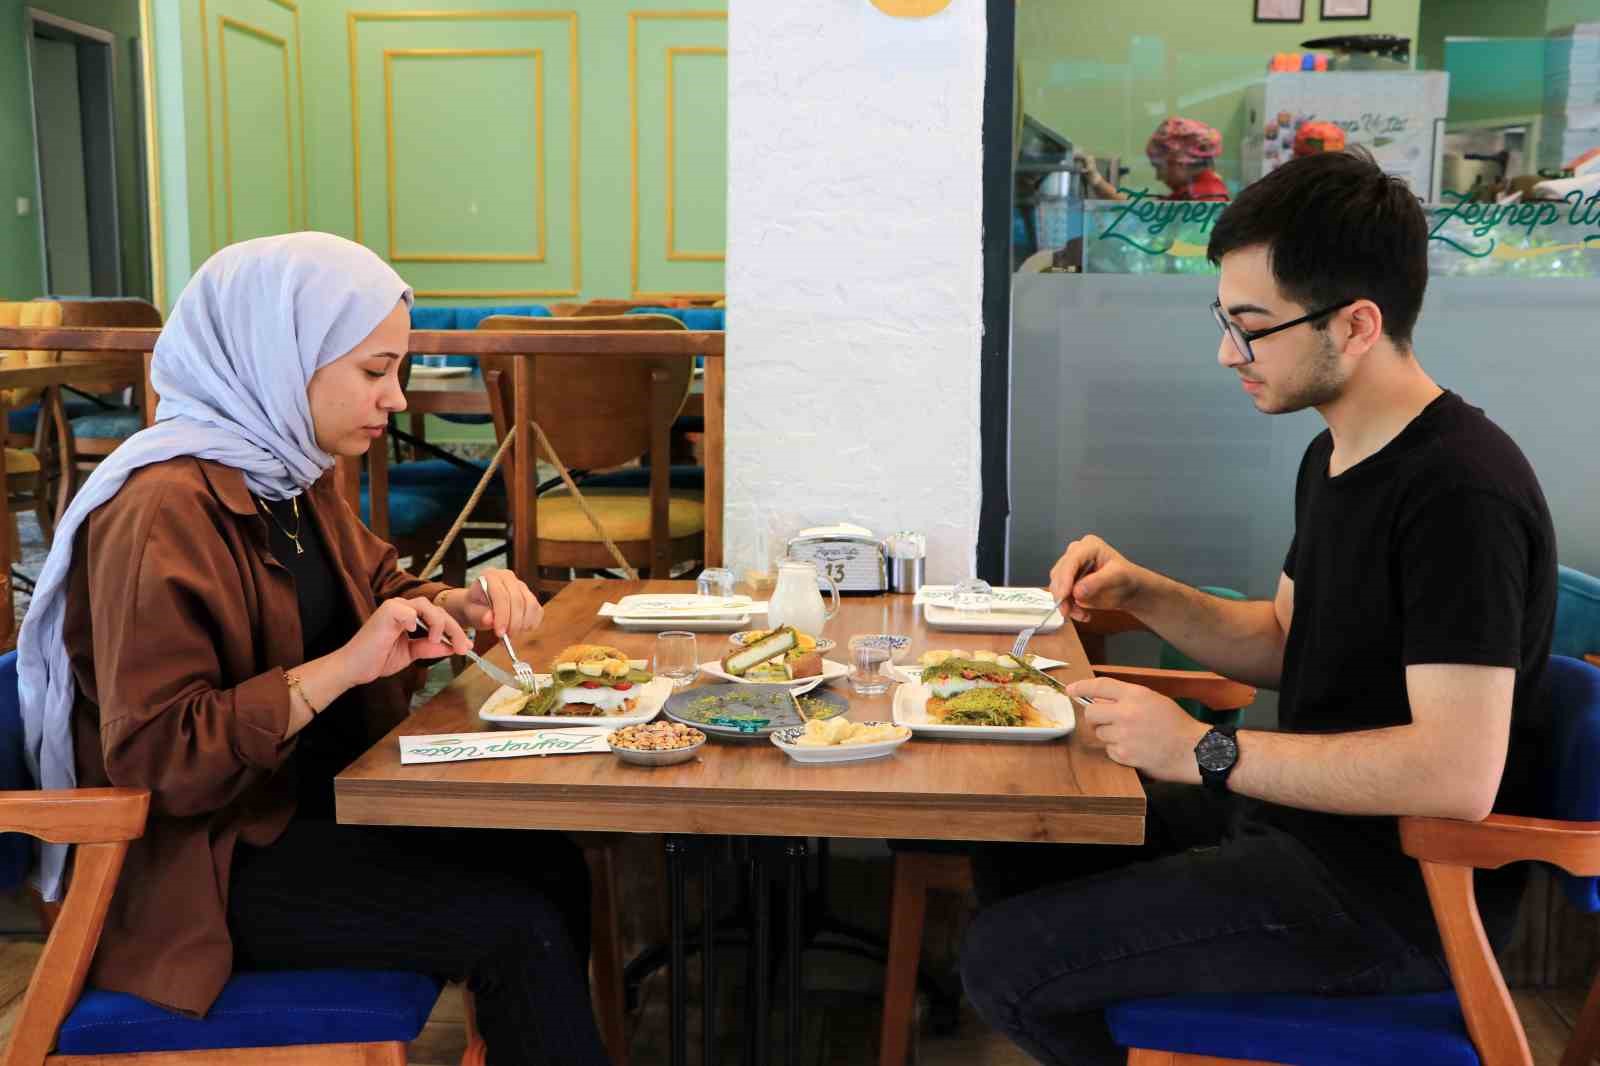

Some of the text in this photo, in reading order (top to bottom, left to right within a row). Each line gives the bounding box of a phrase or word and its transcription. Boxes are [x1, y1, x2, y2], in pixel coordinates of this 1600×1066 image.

[1429, 189, 1600, 258] Zeynep U
[825, 563, 845, 583] 13
[409, 732, 603, 757] Zeynep Usta
